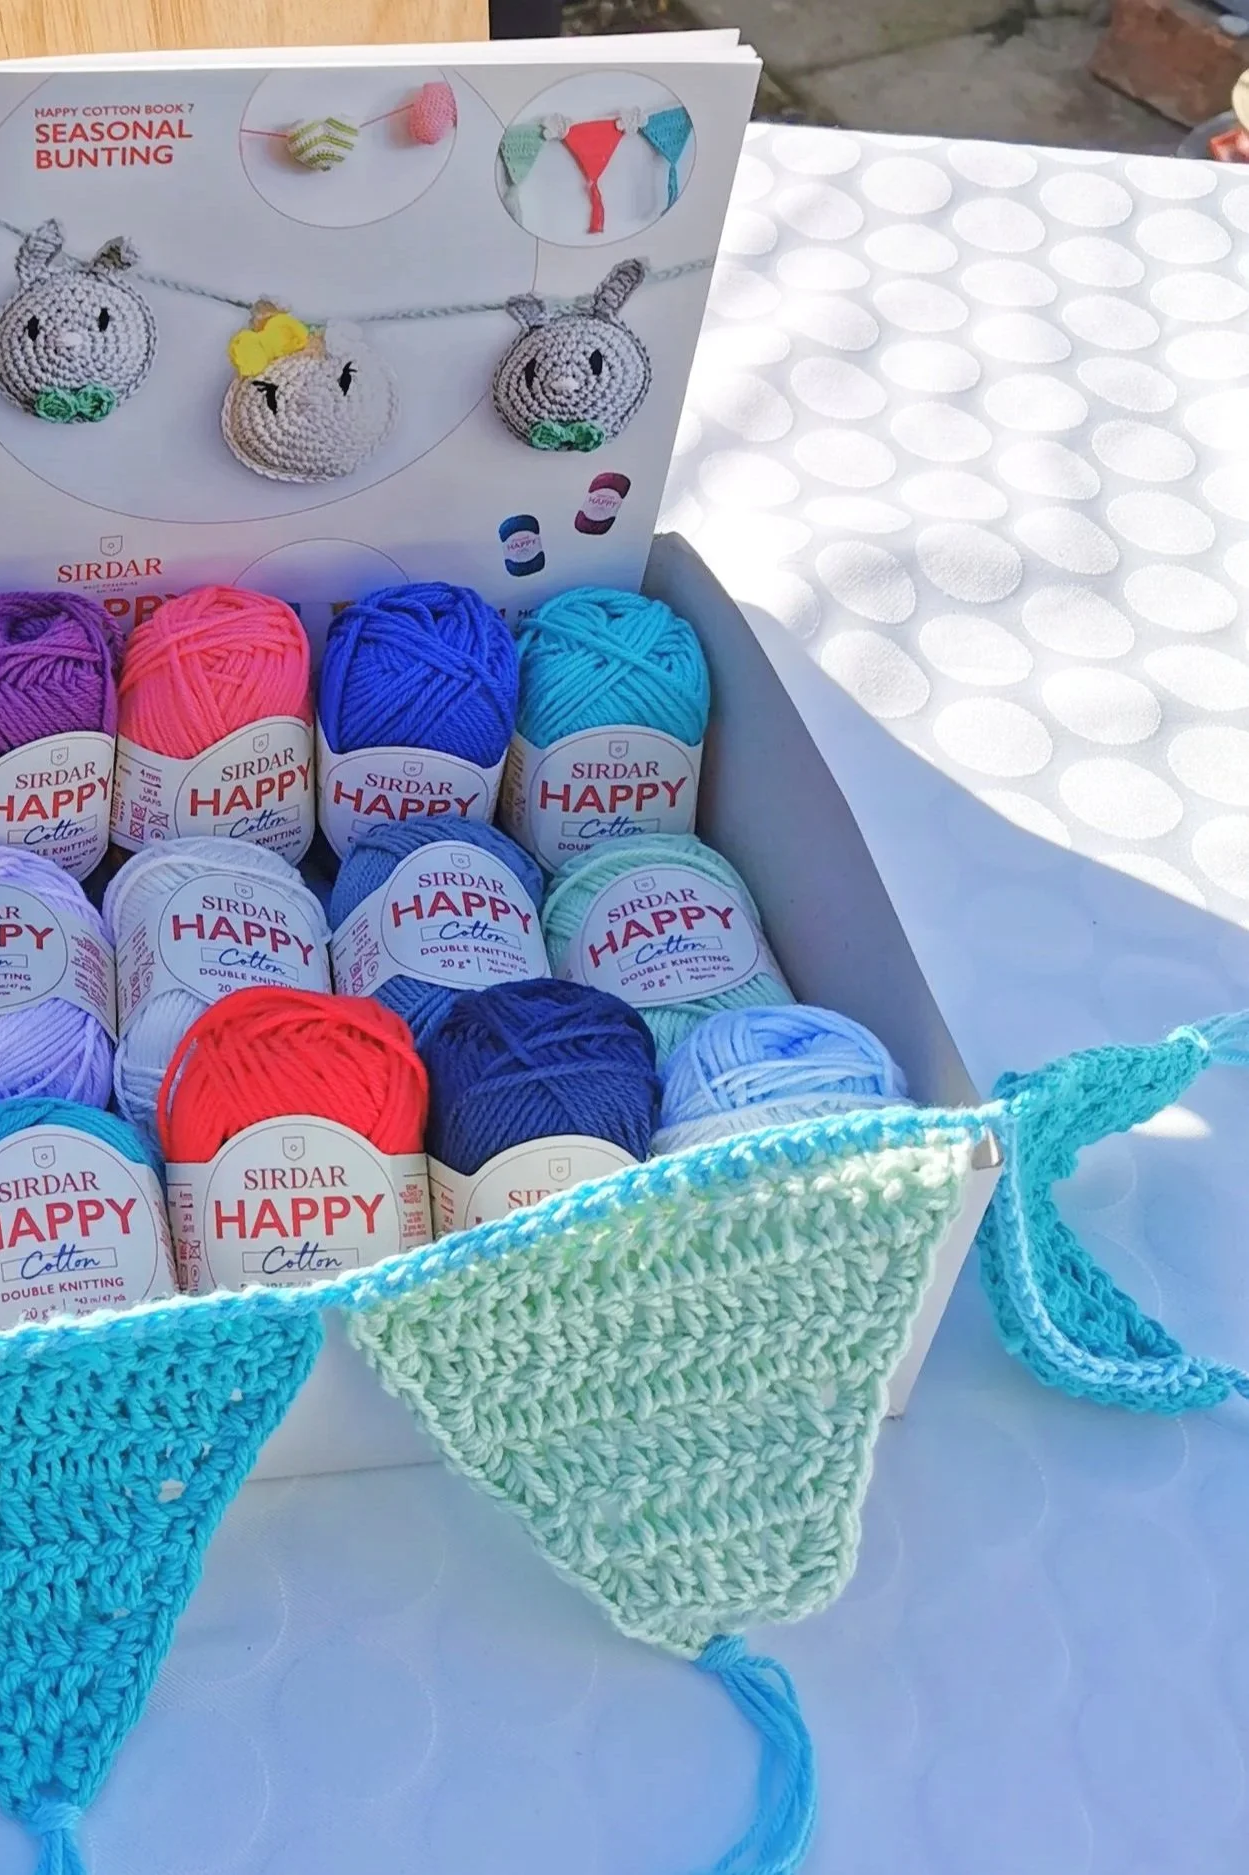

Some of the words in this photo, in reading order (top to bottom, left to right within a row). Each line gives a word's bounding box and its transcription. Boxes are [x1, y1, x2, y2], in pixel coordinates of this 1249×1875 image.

[35, 108, 78, 118] HAPPY
[82, 105, 140, 116] COTTON
[145, 104, 183, 114] BOOK
[188, 104, 194, 114] 7
[35, 119, 193, 143] SEASONAL
[36, 145, 173, 169] BUNTING
[589, 496, 618, 508] HAPPY
[58, 558, 162, 583] SIRDAR
[15, 762, 96, 790] SIRDAR
[221, 747, 295, 782] SIRDAR
[571, 761, 660, 779] SIRDAR
[189, 757, 312, 817] HAPPY
[365, 773, 453, 795] SIRDAR
[539, 776, 688, 814] HAPPY
[333, 780, 480, 821] HAPPY
[24, 819, 86, 845] Cotton
[229, 809, 288, 838] Cotton
[253, 826, 302, 846] KNITTING
[578, 816, 646, 839] Cotton
[52, 835, 98, 856] KNITTING
[418, 872, 507, 895] SIRDAR
[202, 895, 288, 927] SIRDAR
[391, 890, 532, 935] HAPPY
[607, 887, 699, 924] SIRDAR
[172, 913, 315, 966] HAPPY
[439, 921, 509, 944] Cotton
[588, 905, 735, 969] HAPPY
[218, 948, 286, 976] Cotton
[420, 945, 469, 956] DOUBLE
[473, 946, 527, 965] KNITTING
[635, 934, 707, 965] Cotton
[199, 968, 246, 981] DOUBLE
[440, 959, 454, 969] 20
[620, 962, 667, 986] DOUBLE
[670, 954, 731, 969] KNITTING
[218, 983, 231, 993] 20
[640, 980, 656, 992] 20
[244, 1165, 349, 1191] SIRDAR
[214, 1193, 385, 1240] HAPPY
[20, 1243, 100, 1280] Cotton
[262, 1241, 343, 1275] Cotton
[0, 1284, 54, 1303] DOUBLE
[59, 1277, 124, 1292] KNITTING
